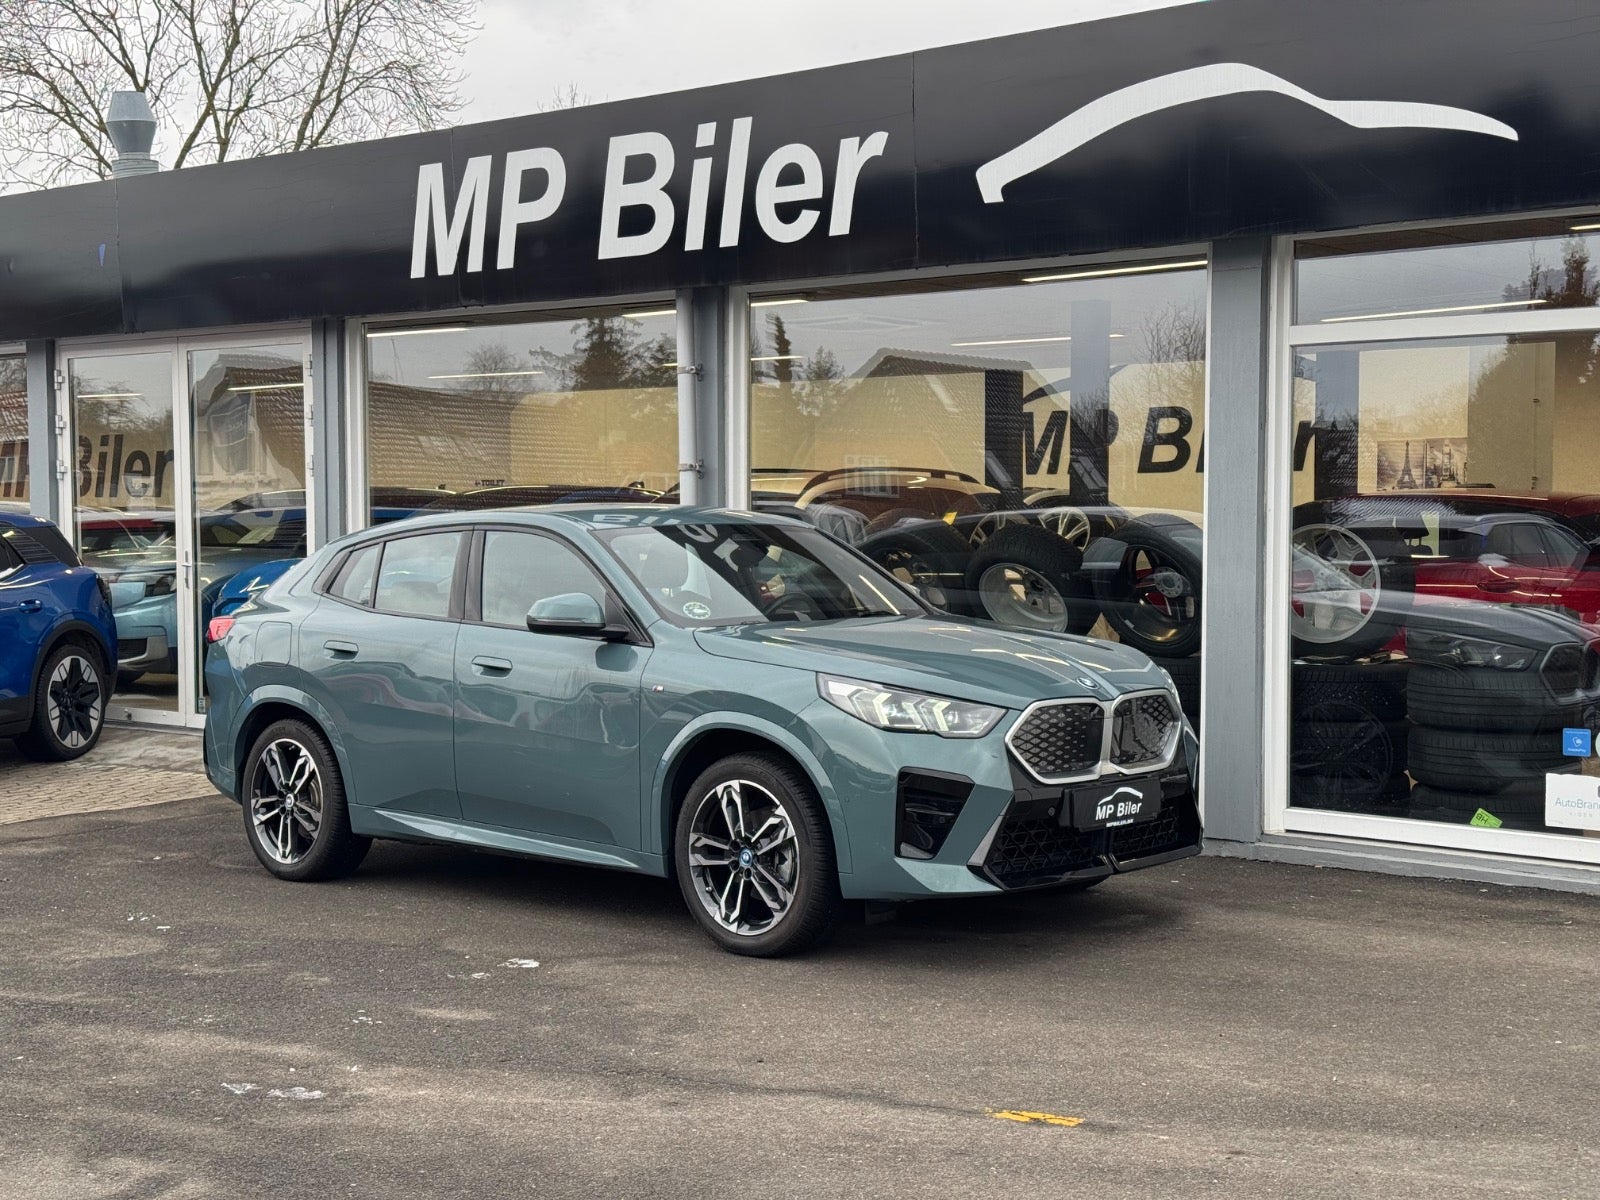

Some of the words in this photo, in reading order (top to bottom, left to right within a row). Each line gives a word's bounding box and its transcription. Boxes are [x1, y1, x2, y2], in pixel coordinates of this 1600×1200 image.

[411, 147, 567, 279] MP
[597, 116, 889, 260] Biler
[1096, 804, 1114, 820] MP
[1117, 801, 1142, 817] Biler
[1555, 797, 1600, 810] AutoBran
